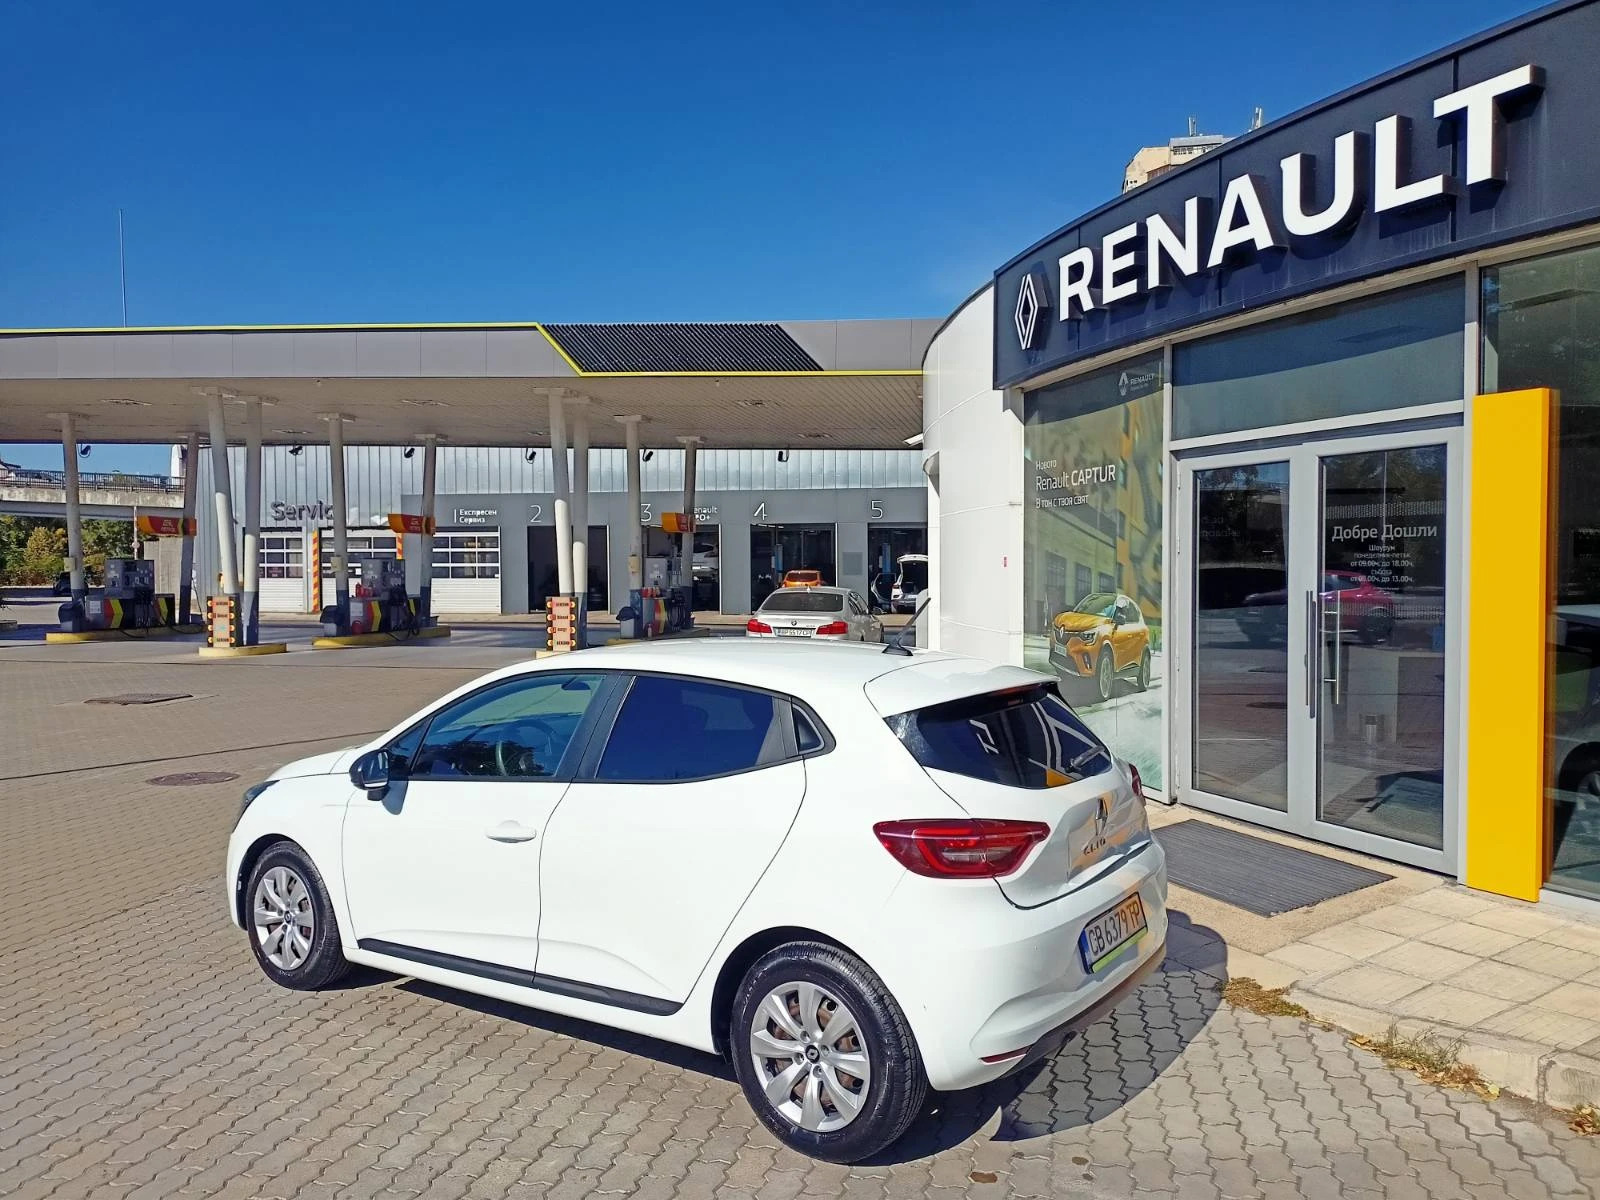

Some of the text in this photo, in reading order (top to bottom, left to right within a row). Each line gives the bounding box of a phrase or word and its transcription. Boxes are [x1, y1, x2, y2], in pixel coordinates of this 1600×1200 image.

[1059, 64, 1537, 321] RENAULT
[1130, 373, 1155, 385] RENAULT
[1036, 464, 1116, 491] Renault CAPTUR
[271, 500, 334, 521] Servic
[459, 508, 497, 517] Експресен
[640, 503, 652, 522] 3
[693, 506, 718, 514] enault
[753, 502, 768, 521] 4
[870, 500, 883, 519] 5
[1035, 498, 1041, 509] В
[459, 516, 486, 524] Сервиз
[530, 504, 542, 522] 2
[1332, 524, 1437, 542] Добре Дошли
[1368, 544, 1396, 552] Шоурум
[1083, 838, 1106, 856] CLIO
[1088, 900, 1140, 956] CB 6379 TP
